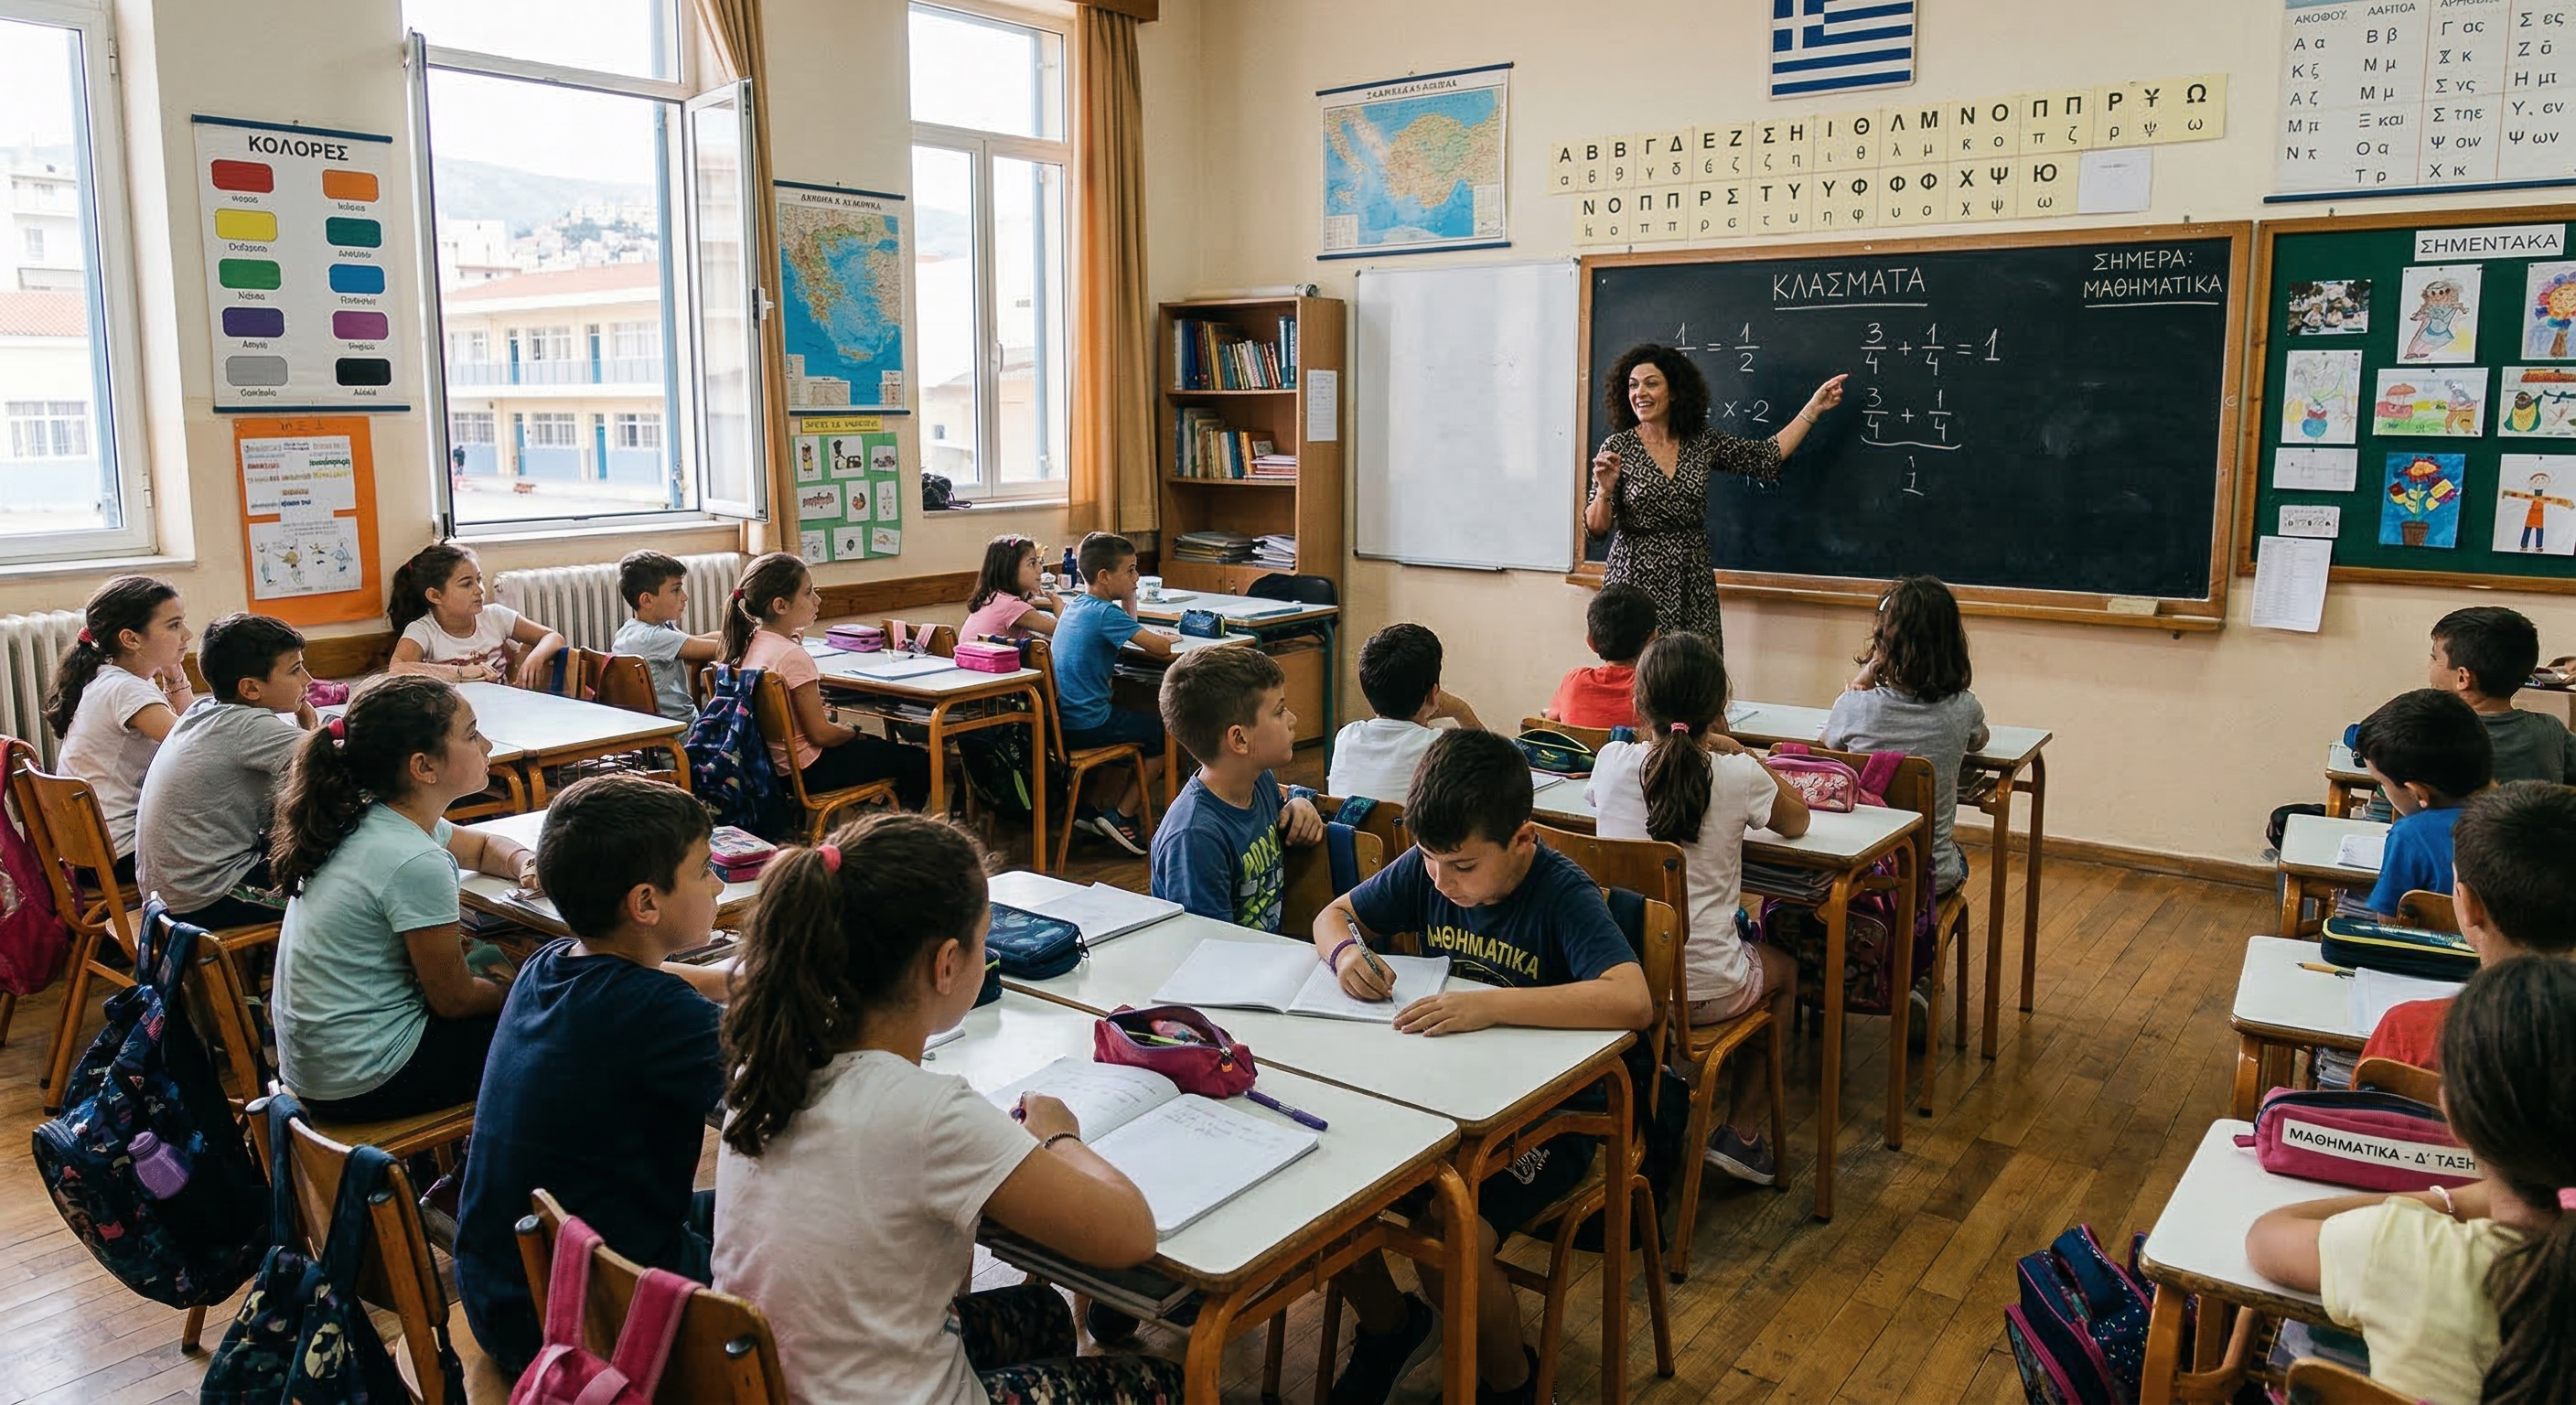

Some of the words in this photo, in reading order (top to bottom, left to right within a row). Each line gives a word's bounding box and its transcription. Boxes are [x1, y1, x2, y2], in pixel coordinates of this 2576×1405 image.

[2441, 20, 2453, 36] Γ
[1646, 138, 1657, 156] Γ
[1669, 135, 1683, 153] Δ
[1763, 126, 1776, 145] Σ
[1853, 117, 1871, 135] Θ
[1890, 113, 1905, 133] Λ
[2032, 99, 2048, 118] Π
[2066, 95, 2082, 115] Π
[2186, 83, 2207, 104] Ω
[248, 134, 349, 162] ΚΟΛΟΡΕΣ
[1892, 142, 1902, 156] λ
[2187, 118, 2204, 131] ω
[1639, 194, 1652, 211] Π
[1667, 192, 1680, 209] Π
[1727, 188, 1739, 206] Σ
[1851, 177, 1868, 197] Φ
[1889, 175, 1906, 193] Φ
[1919, 172, 1938, 191] Φ
[1990, 166, 2009, 186] Ψ
[1852, 209, 1864, 224] φ
[2037, 197, 2053, 209] ω
[2420, 233, 2559, 254] ΣΗΜΕΝΤΑΚΑ
[2092, 249, 2194, 273] ΣΗΜΕΡΑ:
[1773, 266, 1926, 302] ΚΛΑΣΜΑΤΑ
[2083, 273, 2223, 299] ΜΑΘΗΜΑΤΙΚΑ
[1984, 327, 2001, 361] 1
[2289, 1127, 2400, 1161] ΜΑΘΗΜΑΤΙΚΑ
[2434, 1154, 2476, 1171] ΤΑΞΗ
